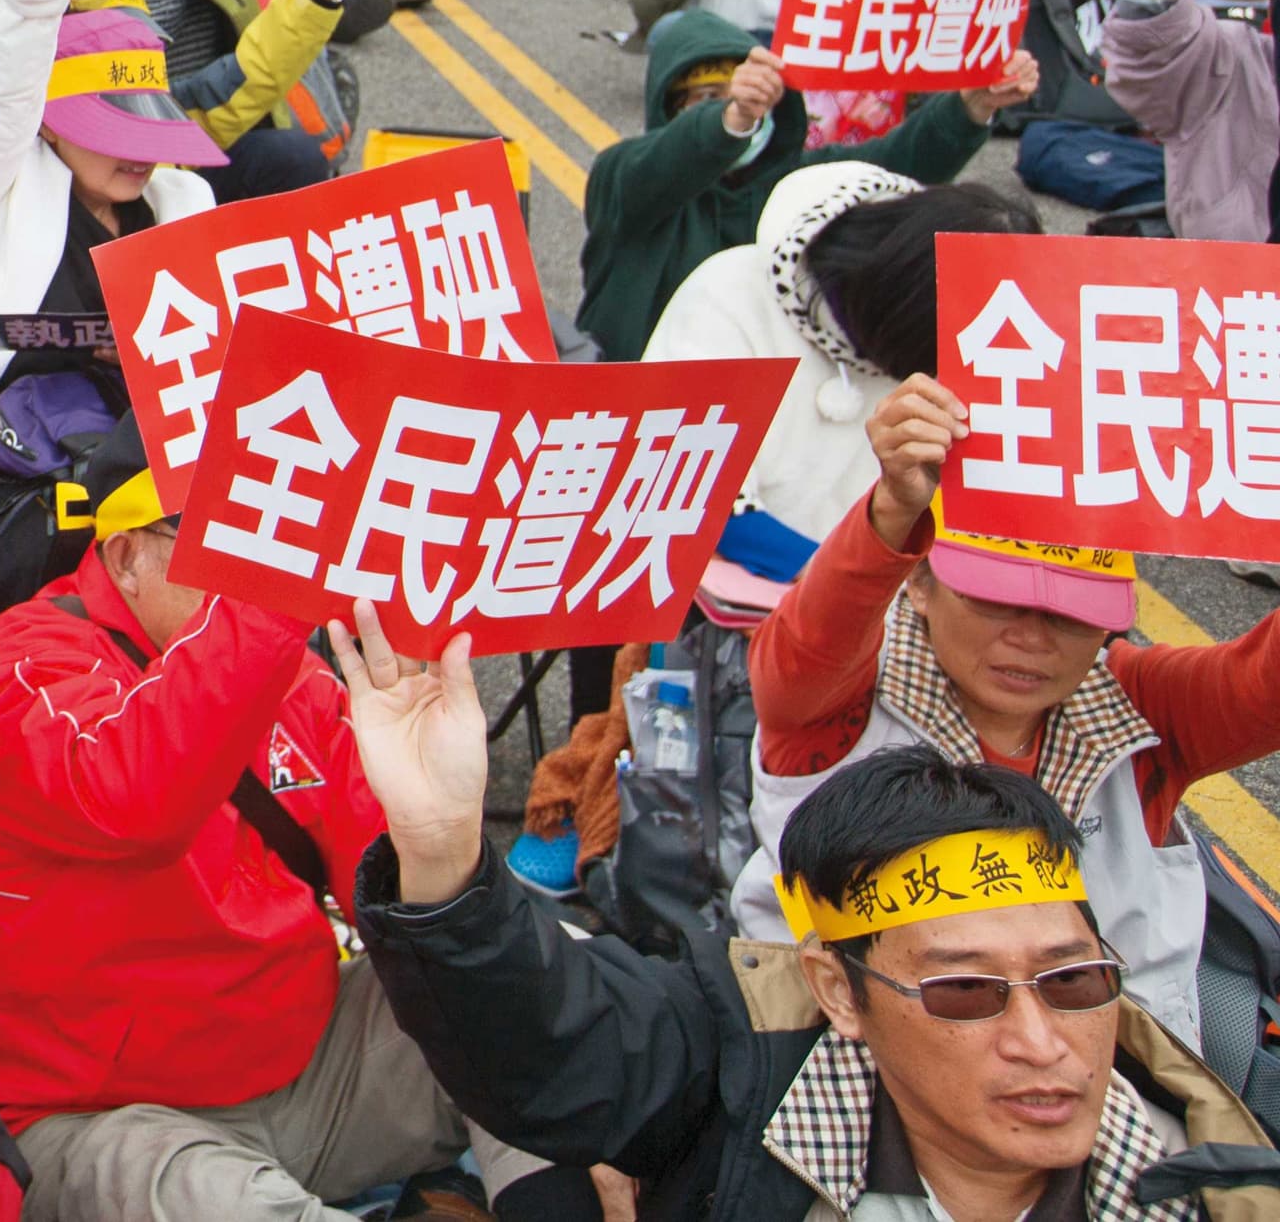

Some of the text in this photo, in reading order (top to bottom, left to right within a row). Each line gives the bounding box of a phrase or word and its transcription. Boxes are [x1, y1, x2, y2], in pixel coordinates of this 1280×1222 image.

[107, 59, 169, 87] 執政
[203, 369, 739, 626] 全民遭殃
[846, 842, 1069, 923] 執政無能
